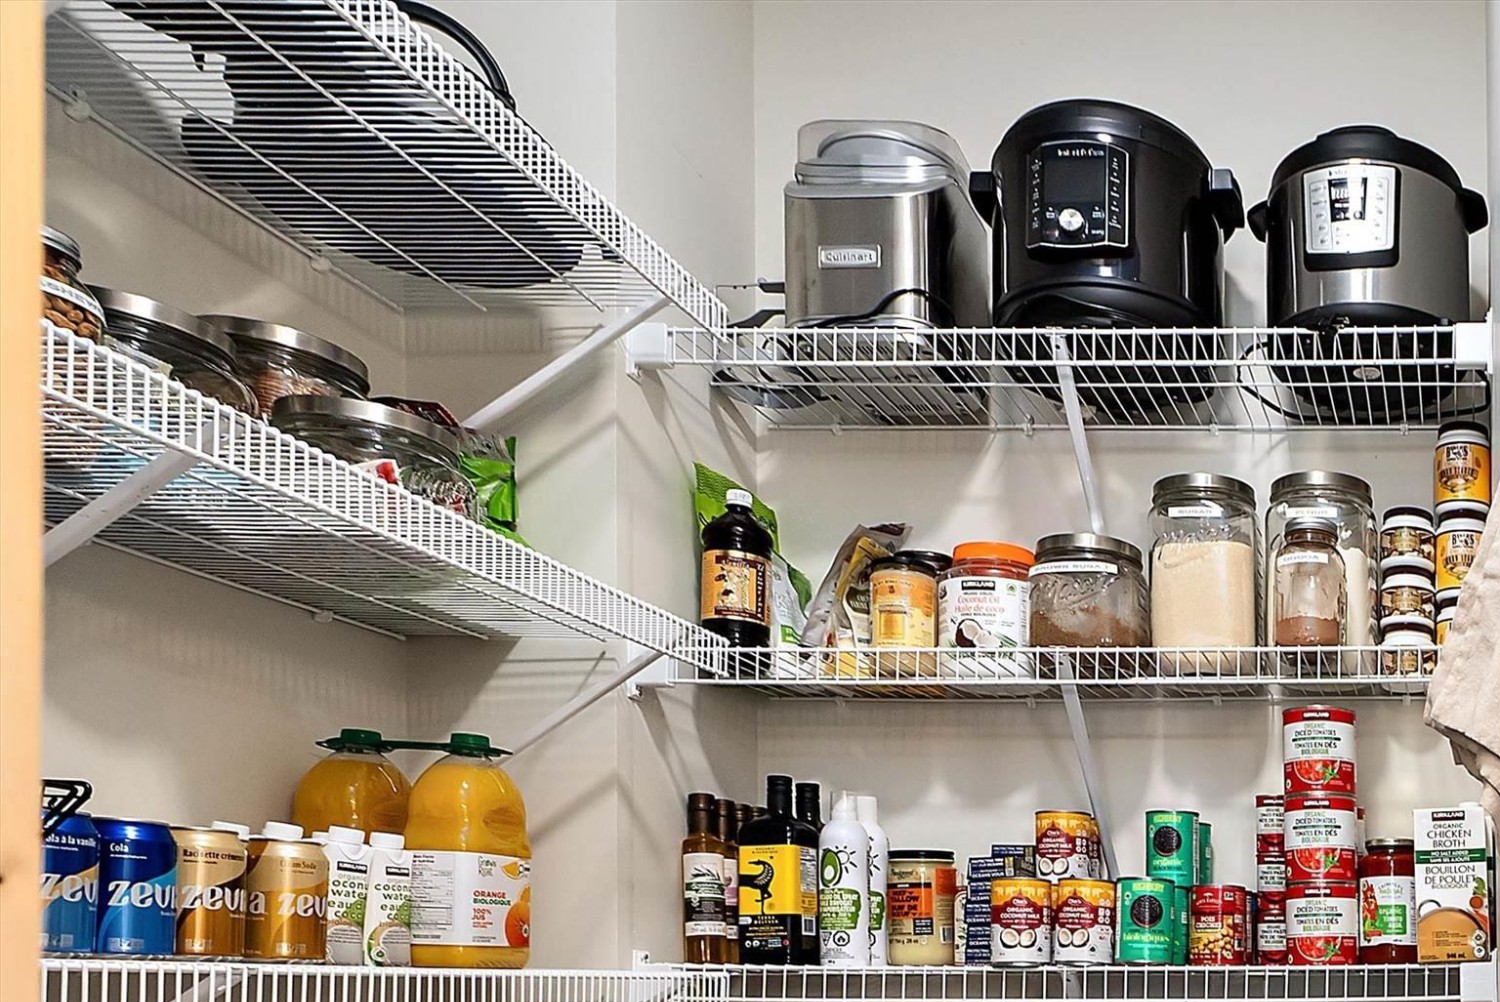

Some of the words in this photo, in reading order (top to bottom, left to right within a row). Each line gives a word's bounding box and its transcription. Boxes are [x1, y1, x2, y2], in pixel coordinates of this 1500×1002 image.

[826, 251, 873, 262] Cuisinart
[957, 595, 988, 604] Coconut
[954, 604, 973, 613] Huile
[985, 606, 1005, 614] coco
[1427, 829, 1471, 839] CHICKEN
[68, 836, 75, 844] la
[76, 837, 98, 848] vanill
[1433, 839, 1465, 848] BROTH
[110, 843, 129, 853] Cola
[183, 849, 220, 859] Racette
[1425, 865, 1475, 875] BOUILLON
[332, 879, 361, 890] ocon
[1425, 875, 1437, 885] DE
[1439, 875, 1476, 885] POULET
[41, 873, 97, 904] zev
[374, 883, 408, 892] cocon
[107, 880, 176, 909] zevi
[473, 890, 506, 899] ORANGE
[278, 893, 326, 918] zev
[327, 900, 354, 909] eau
[472, 899, 511, 907] BIOLOGIQUE
[334, 911, 363, 920] coco
[387, 913, 409, 921] coco
